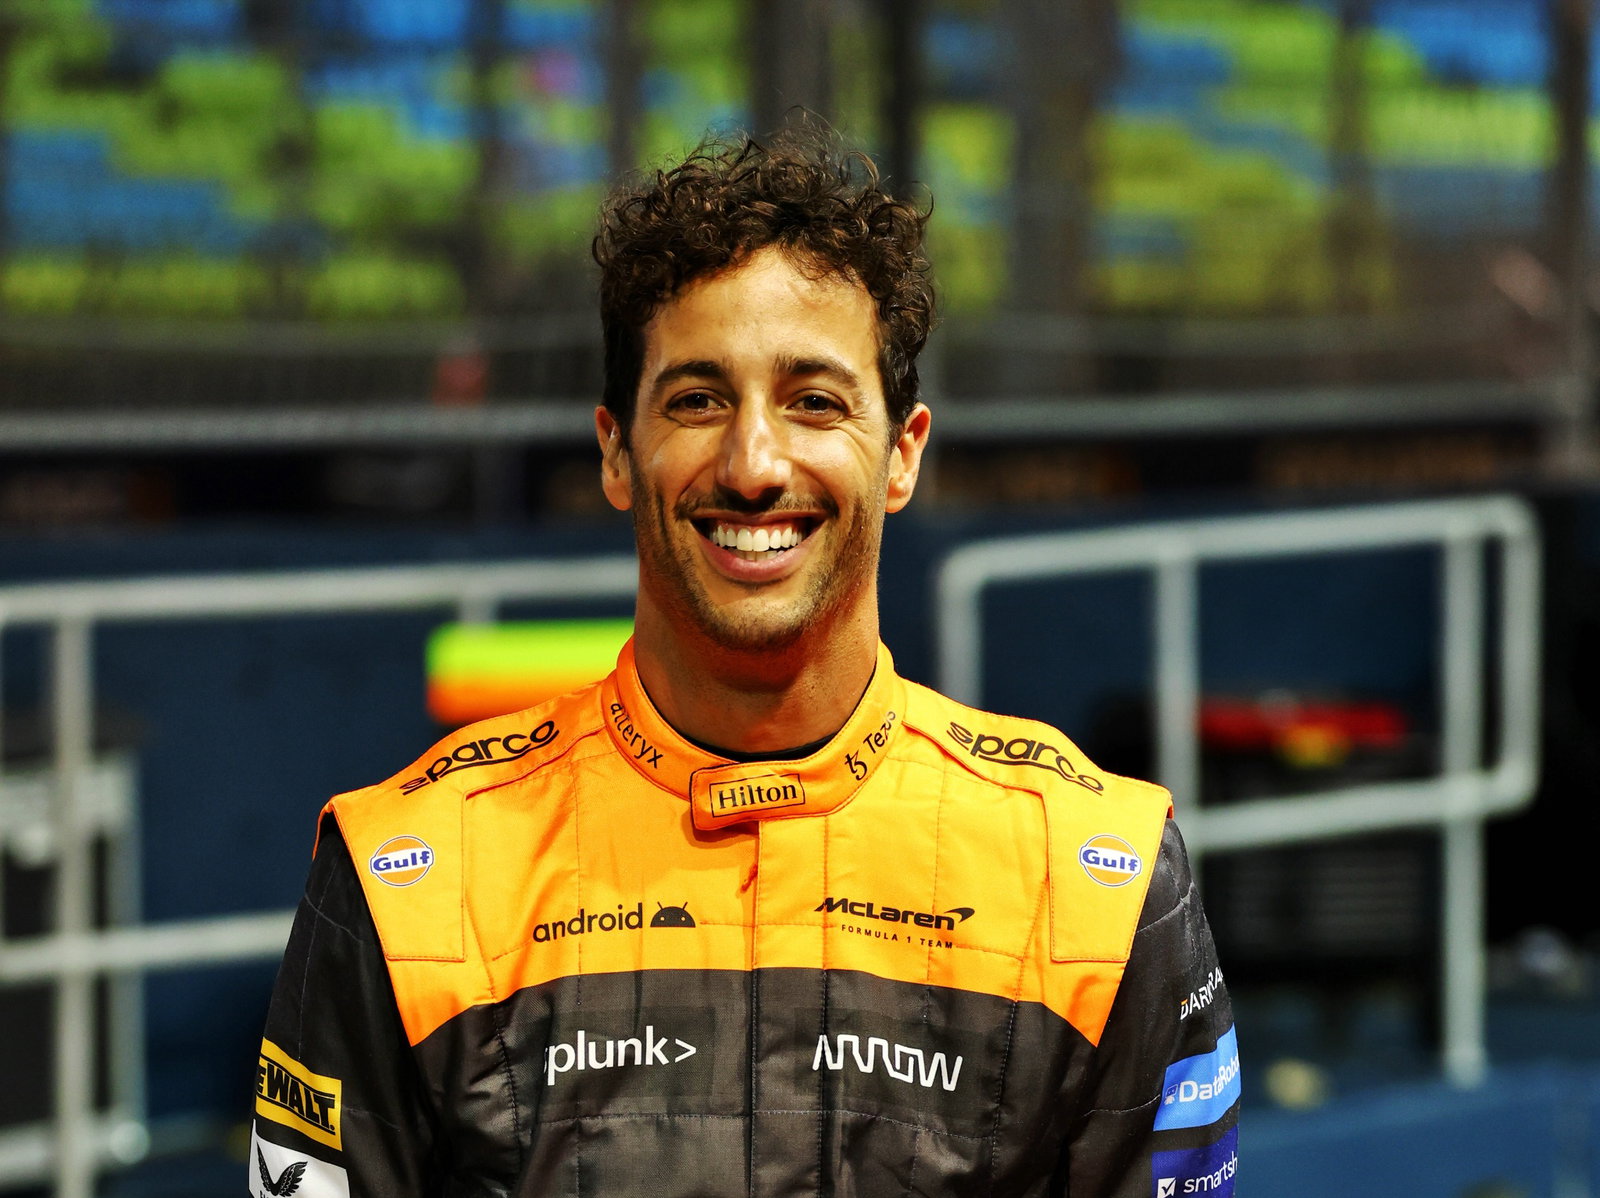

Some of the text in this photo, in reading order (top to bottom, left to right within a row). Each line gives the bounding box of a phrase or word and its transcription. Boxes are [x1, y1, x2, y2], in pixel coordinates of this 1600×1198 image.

[399, 720, 558, 792] sparco
[948, 721, 1104, 792] sparco
[718, 783, 798, 810] Hilton
[372, 850, 431, 872] Gulf
[1082, 849, 1139, 872] Gulf
[532, 902, 643, 943] android
[814, 897, 956, 931] McLaren
[841, 924, 953, 949] FORMULA 1 TEAM
[543, 1025, 697, 1086] plunk>
[1183, 1150, 1238, 1194] smartsh
